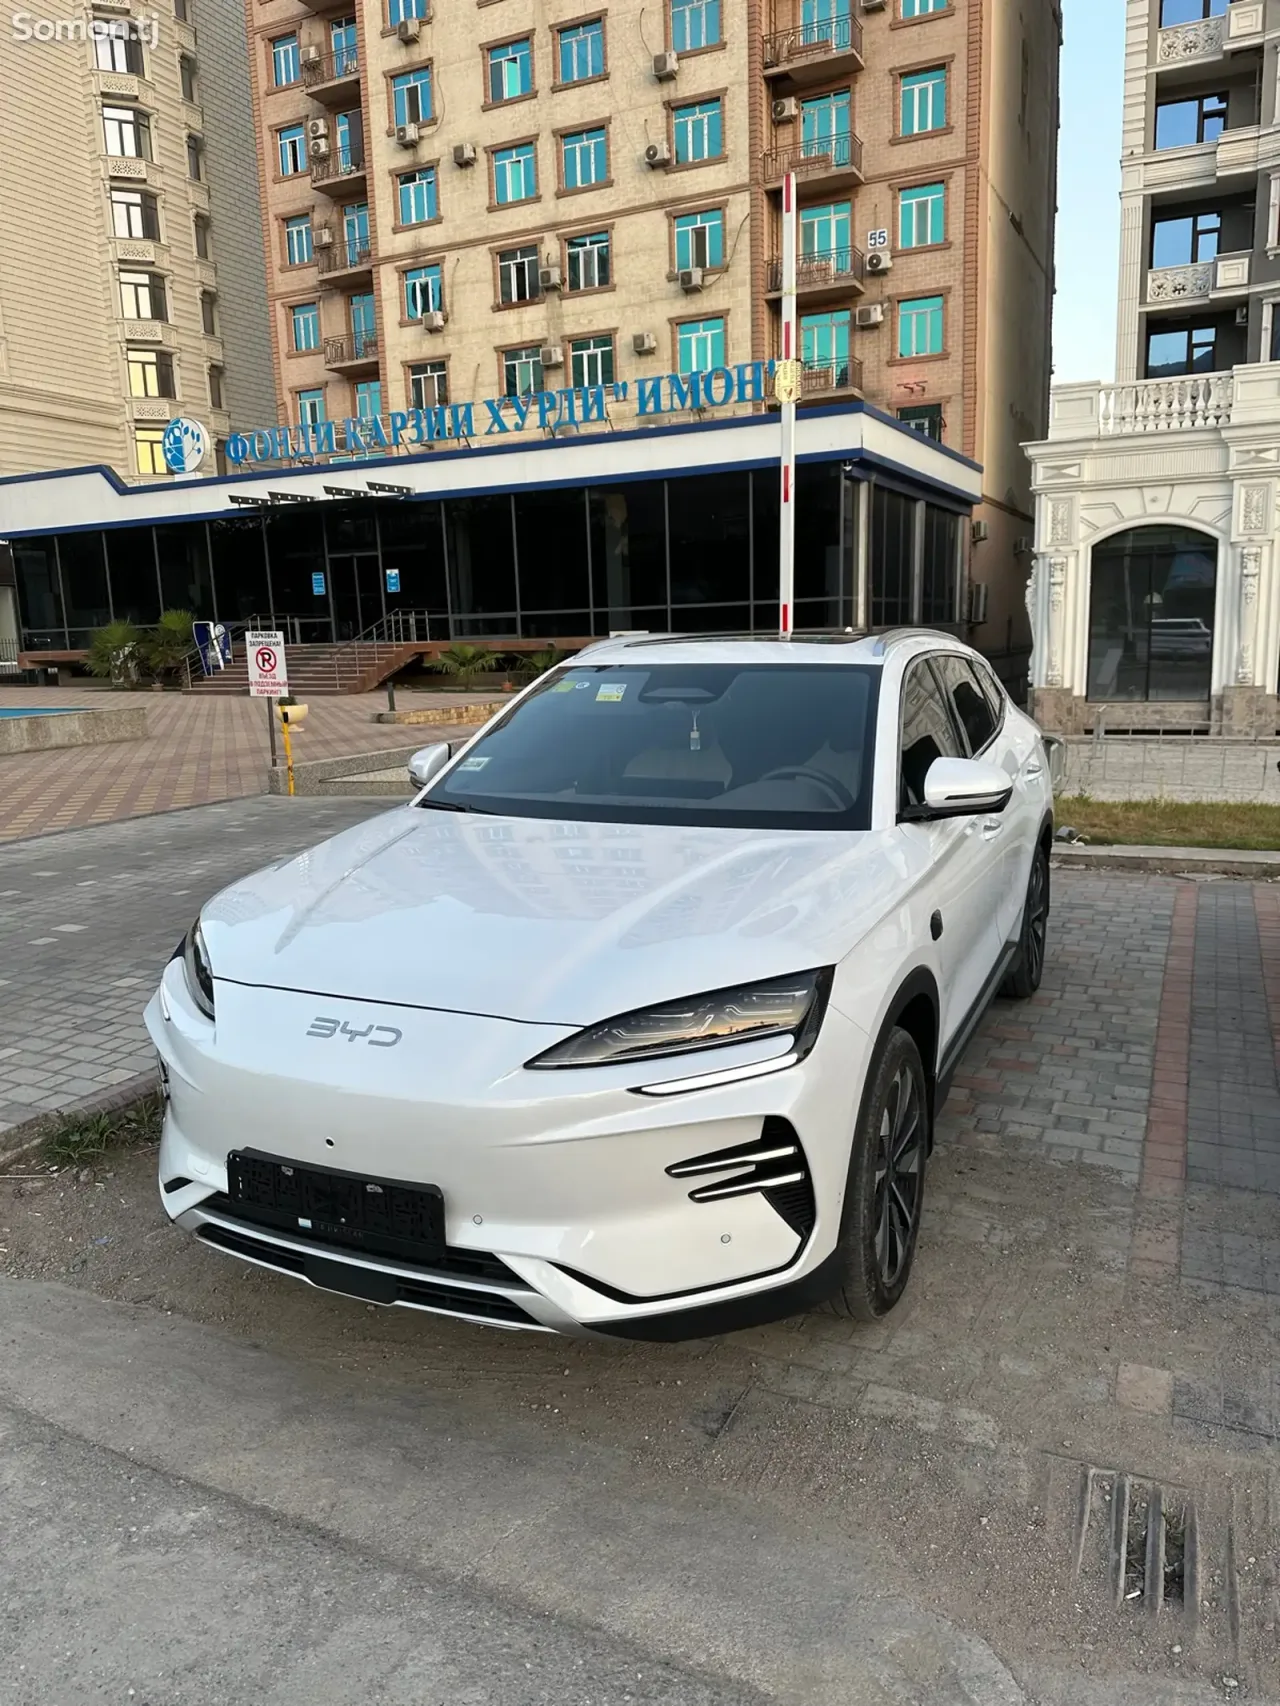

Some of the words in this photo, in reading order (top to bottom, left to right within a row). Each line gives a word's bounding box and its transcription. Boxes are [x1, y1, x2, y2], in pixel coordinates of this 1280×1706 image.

[869, 230, 887, 247] 55
[226, 422, 337, 465] ФОНДИ
[344, 402, 477, 451] КАРЗИИ
[483, 383, 608, 433] ХУРДИ
[306, 1016, 402, 1047] BYD
